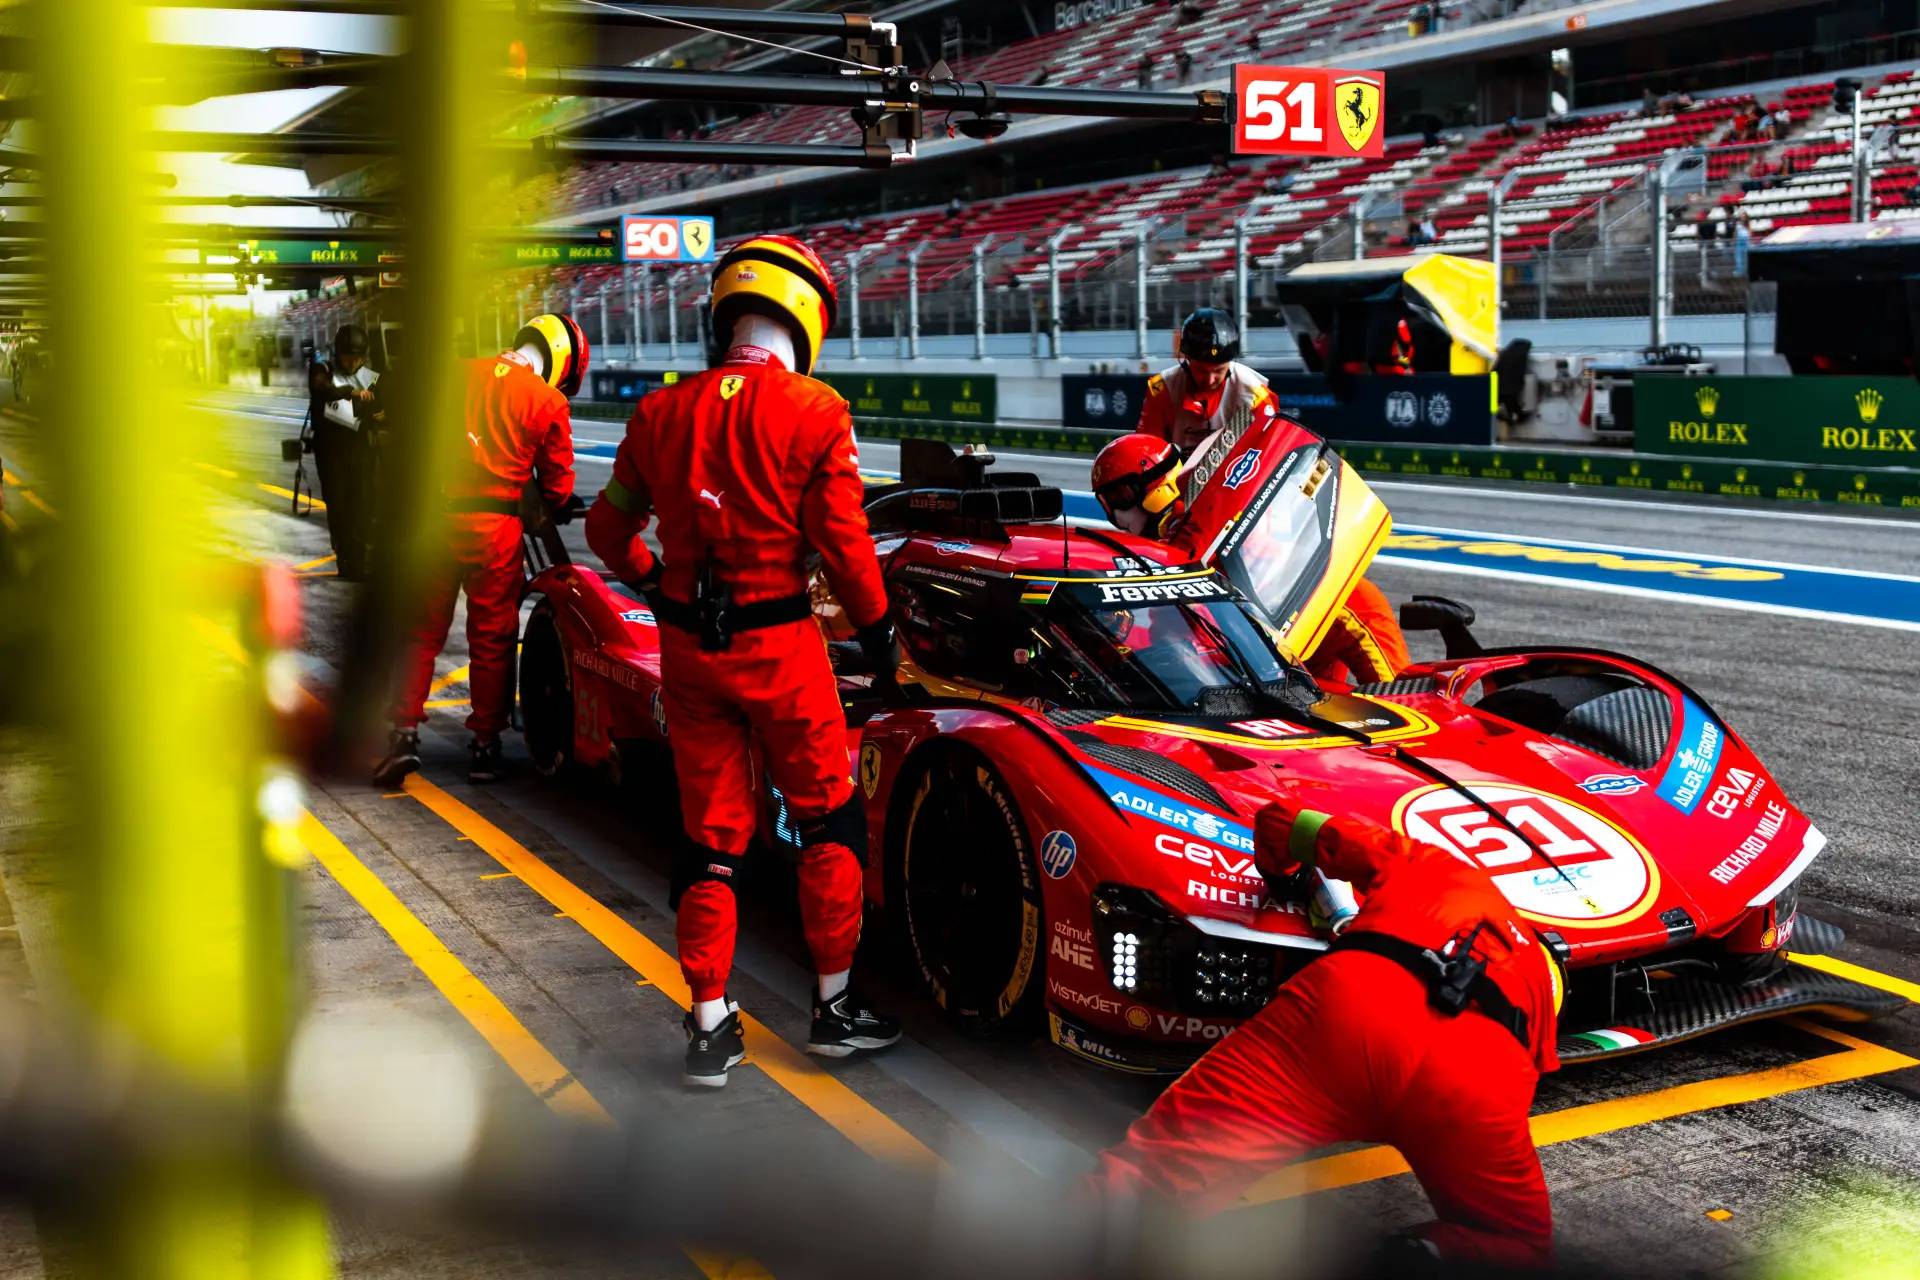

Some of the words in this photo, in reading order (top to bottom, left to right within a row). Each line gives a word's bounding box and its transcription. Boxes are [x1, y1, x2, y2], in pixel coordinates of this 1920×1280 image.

[1245, 79, 1322, 142] 51
[517, 246, 560, 258] ROLEX
[627, 223, 678, 256] 50
[311, 250, 358, 263] ROLEX
[1386, 400, 1415, 418] FIA
[1668, 421, 1748, 445] ROLEX
[1821, 426, 1917, 451] ROLEX
[1667, 479, 1704, 492] ROLEX
[1719, 482, 1760, 495] ROLEX
[1776, 487, 1819, 500] ROLEX
[1837, 491, 1882, 504] ROLEX
[1253, 488, 1272, 512] CALADO
[1098, 577, 1229, 603] Ferrari
[573, 649, 609, 678] RICHARD
[578, 688, 601, 742] 51
[1230, 718, 1304, 738] HY
[1672, 769, 1705, 808] ADLER
[1696, 721, 1719, 760] GROUP
[1743, 777, 1766, 808] LOGISTICS
[1110, 791, 1189, 828] ADLER
[1439, 804, 1598, 868] 51
[1709, 834, 1768, 885] RICHARD
[1754, 800, 1787, 841] MILLE
[1044, 831, 1075, 879] hp
[1210, 870, 1265, 886] LOGISTI
[1533, 865, 1592, 887] WEC
[1187, 879, 1307, 916] RICHAR
[1054, 919, 1092, 944] azimut
[1051, 935, 1095, 970] AHE
